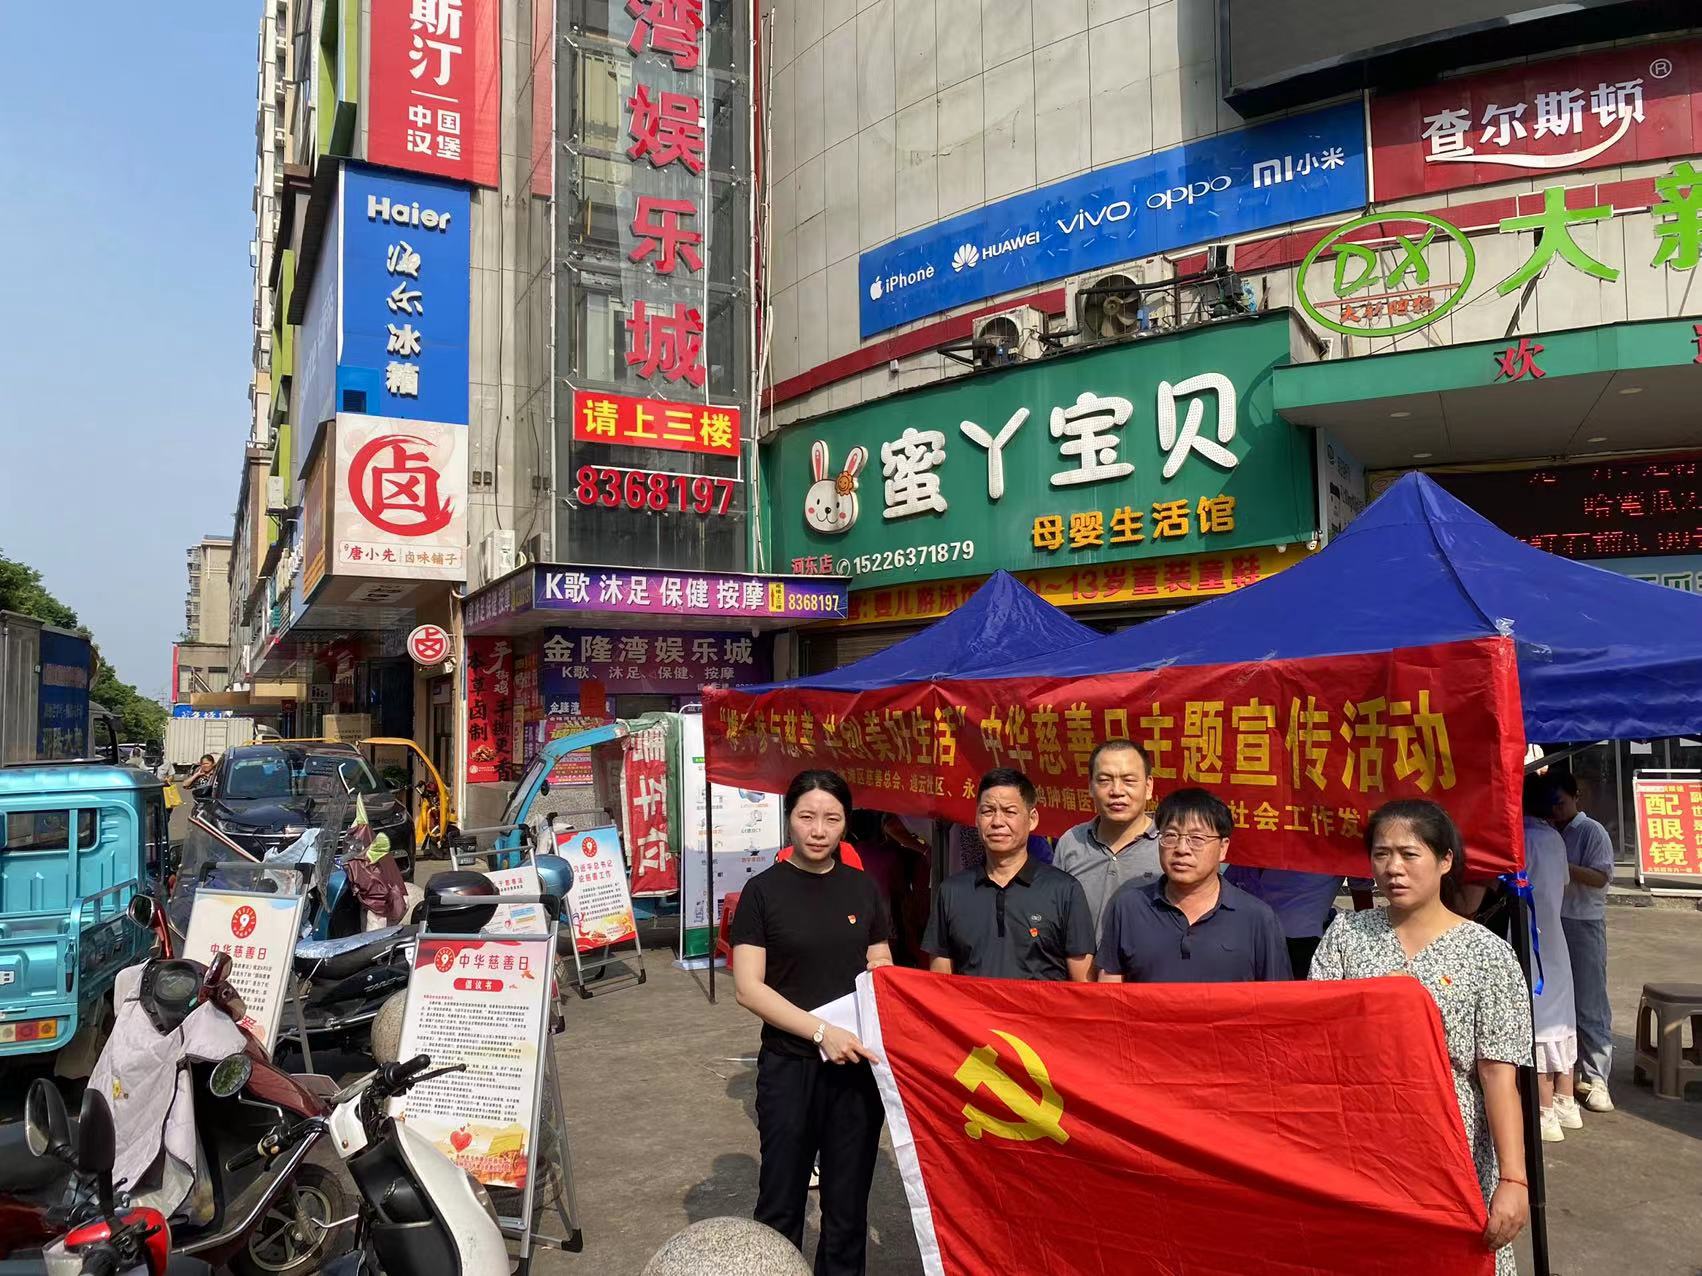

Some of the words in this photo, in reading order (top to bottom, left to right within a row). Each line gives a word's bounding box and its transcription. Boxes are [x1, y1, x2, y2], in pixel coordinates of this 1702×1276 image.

[408, 0, 463, 86] 斯汀
[408, 105, 461, 135] 中国
[1421, 78, 1646, 162] 查尔斯顿
[407, 128, 461, 161] 汉堡
[1296, 146, 1346, 176] 小米
[367, 194, 451, 232] Haier
[624, 0, 706, 390] 湾娱乐城
[981, 231, 1041, 259] HUAWEI
[1332, 223, 1437, 297] DX
[884, 262, 936, 294] iPhone
[385, 240, 424, 397] 海尔冰箱
[583, 399, 734, 450] 请上三楼
[881, 372, 1239, 520] 蜜丫宝贝
[371, 443, 441, 515] 卤
[576, 464, 735, 517] 8368197
[1031, 494, 1238, 552] 母婴生活馆
[347, 545, 397, 563] 唐小先
[404, 550, 457, 566] 卤味铺子
[791, 554, 833, 575] 河东店
[853, 539, 975, 576] 15226371879
[545, 571, 591, 604] K歌
[599, 575, 652, 607] 沐足
[660, 576, 710, 610] 保健
[716, 579, 765, 612] 按摩
[787, 593, 839, 613] 8368197
[543, 634, 754, 665] 金隆湾娱乐城
[1228, 799, 1376, 839] 社会工作发
[1644, 793, 1689, 866] 配眼镜
[210, 943, 268, 961] 中华慈善日
[458, 953, 530, 972] 中华慈善日
